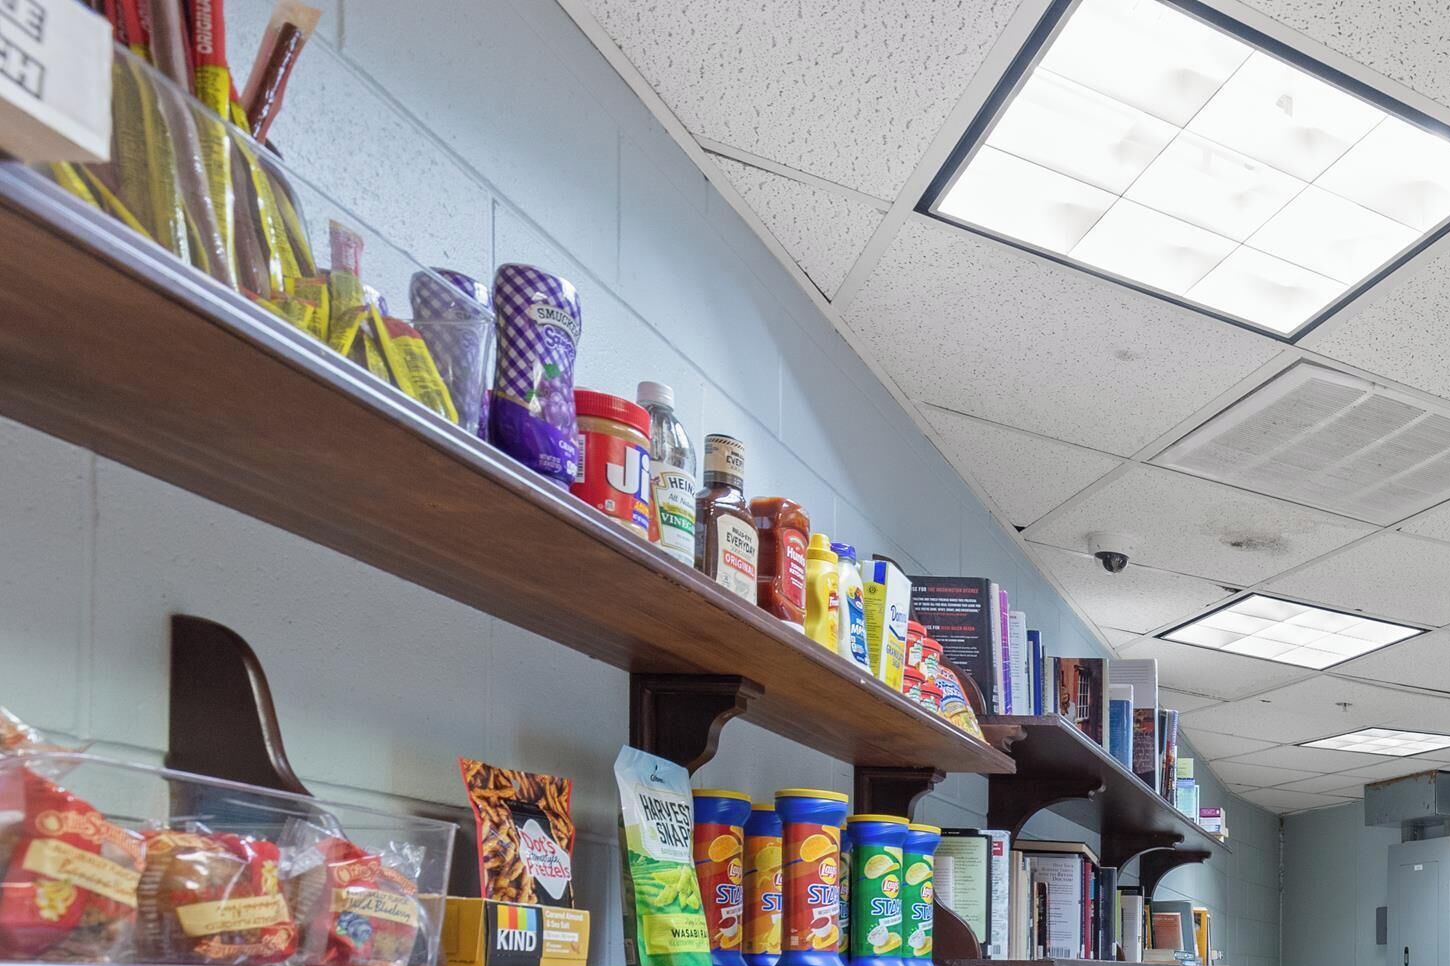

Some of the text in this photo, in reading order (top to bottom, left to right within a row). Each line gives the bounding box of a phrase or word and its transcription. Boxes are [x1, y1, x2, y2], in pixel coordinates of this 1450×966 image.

[724, 554, 755, 577] ORIGINAL
[522, 829, 556, 856] Dot's
[656, 822, 691, 848] SNAP
[527, 858, 571, 880] Pretzels
[496, 928, 538, 952] KIND
